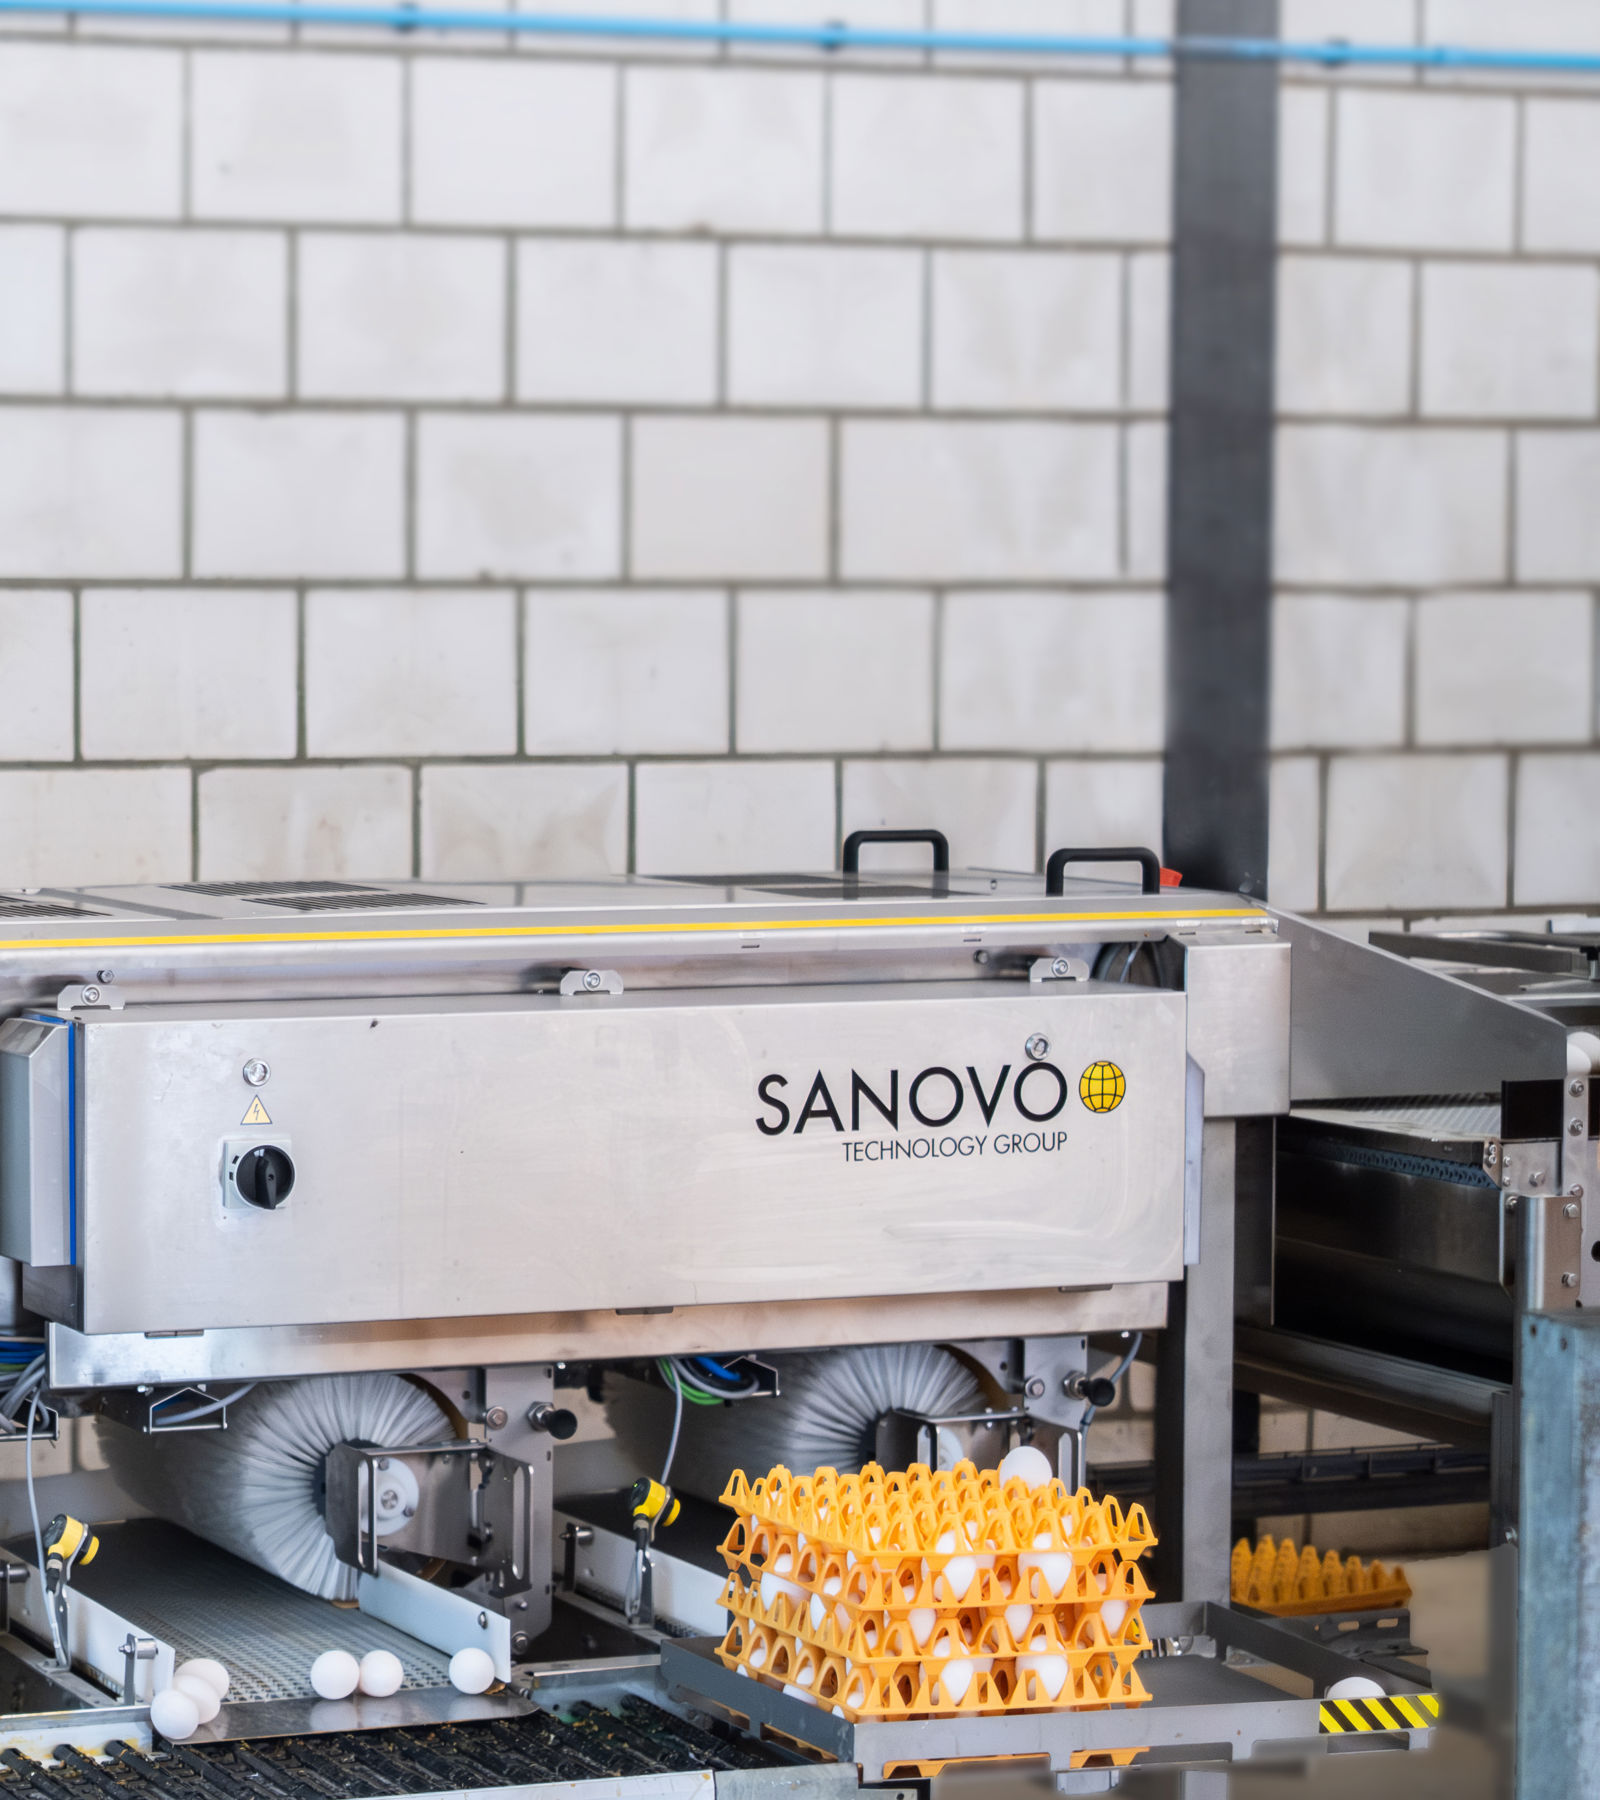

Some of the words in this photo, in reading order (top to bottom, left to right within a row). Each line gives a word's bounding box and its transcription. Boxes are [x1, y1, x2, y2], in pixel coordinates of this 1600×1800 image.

[755, 1062, 1068, 1136] SANOVO
[842, 1136, 988, 1162] TECHNOLOGY
[993, 1131, 1068, 1154] GROUP
